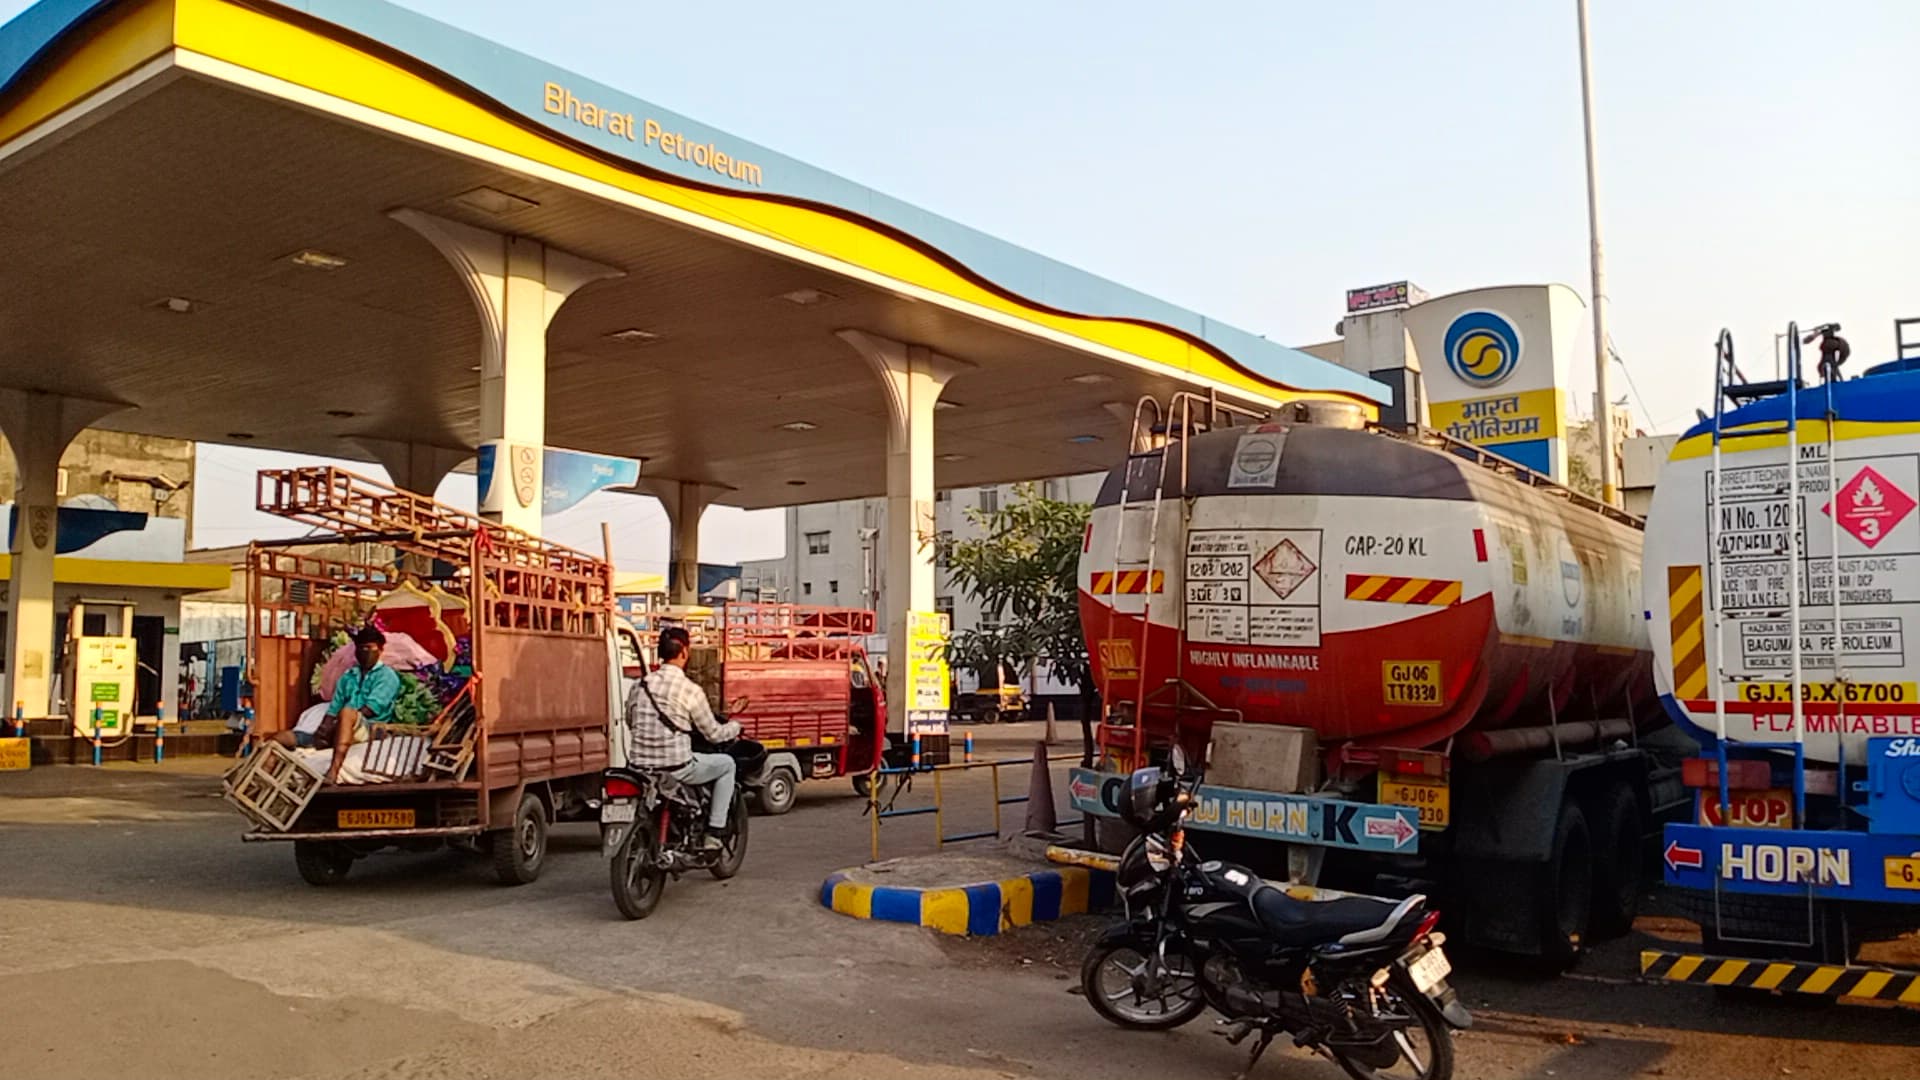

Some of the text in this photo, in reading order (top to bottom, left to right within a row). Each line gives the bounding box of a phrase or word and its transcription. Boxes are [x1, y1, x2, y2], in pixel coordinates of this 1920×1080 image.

[543, 81, 763, 187] Bharat Petroleum
[1461, 396, 1519, 419] भारत
[1736, 505, 1760, 529] No.
[1859, 517, 1880, 541] 3
[1408, 537, 1428, 557] KL
[1863, 558, 1898, 572] ADVICE
[1828, 574, 1851, 588] FAM
[1820, 634, 1893, 651] PEROLEUM
[1189, 650, 1320, 671] HIGHLY INFLAMMABLE
[1226, 800, 1309, 836] HORN
[1322, 803, 1359, 846] K
[1721, 843, 1851, 887] HORN
